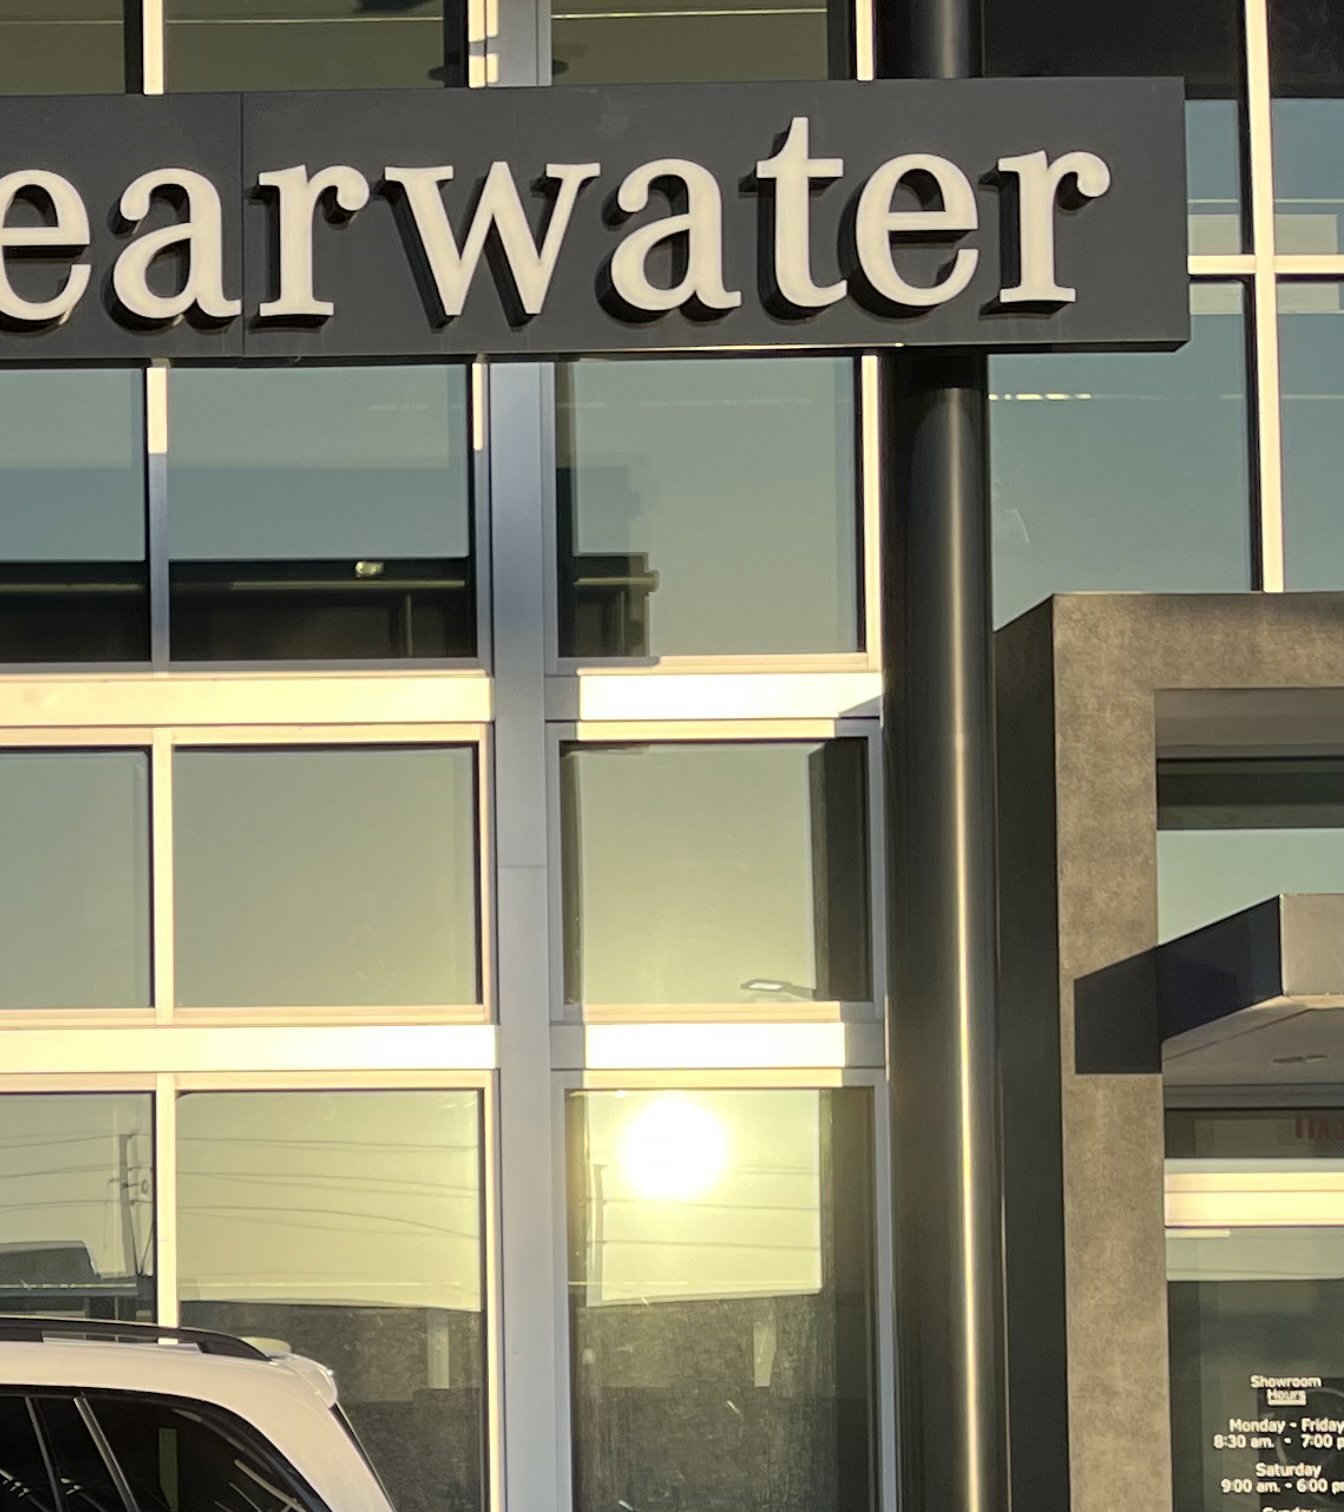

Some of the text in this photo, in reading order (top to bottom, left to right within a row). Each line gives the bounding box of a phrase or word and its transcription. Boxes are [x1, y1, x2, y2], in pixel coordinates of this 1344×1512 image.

[1251, 1375, 1322, 1388] Showroom
[1267, 1389, 1307, 1401] Hours
[1229, 1418, 1286, 1434] Monday
[1301, 1417, 1344, 1435] Friday
[1213, 1434, 1247, 1449] 8:30
[1251, 1437, 1275, 1449] am.
[1300, 1433, 1333, 1449] 7:00
[1255, 1462, 1322, 1478] Saturday
[1220, 1478, 1253, 1493] 9:00
[1256, 1481, 1281, 1493] am.
[1296, 1478, 1328, 1493] 6:00
